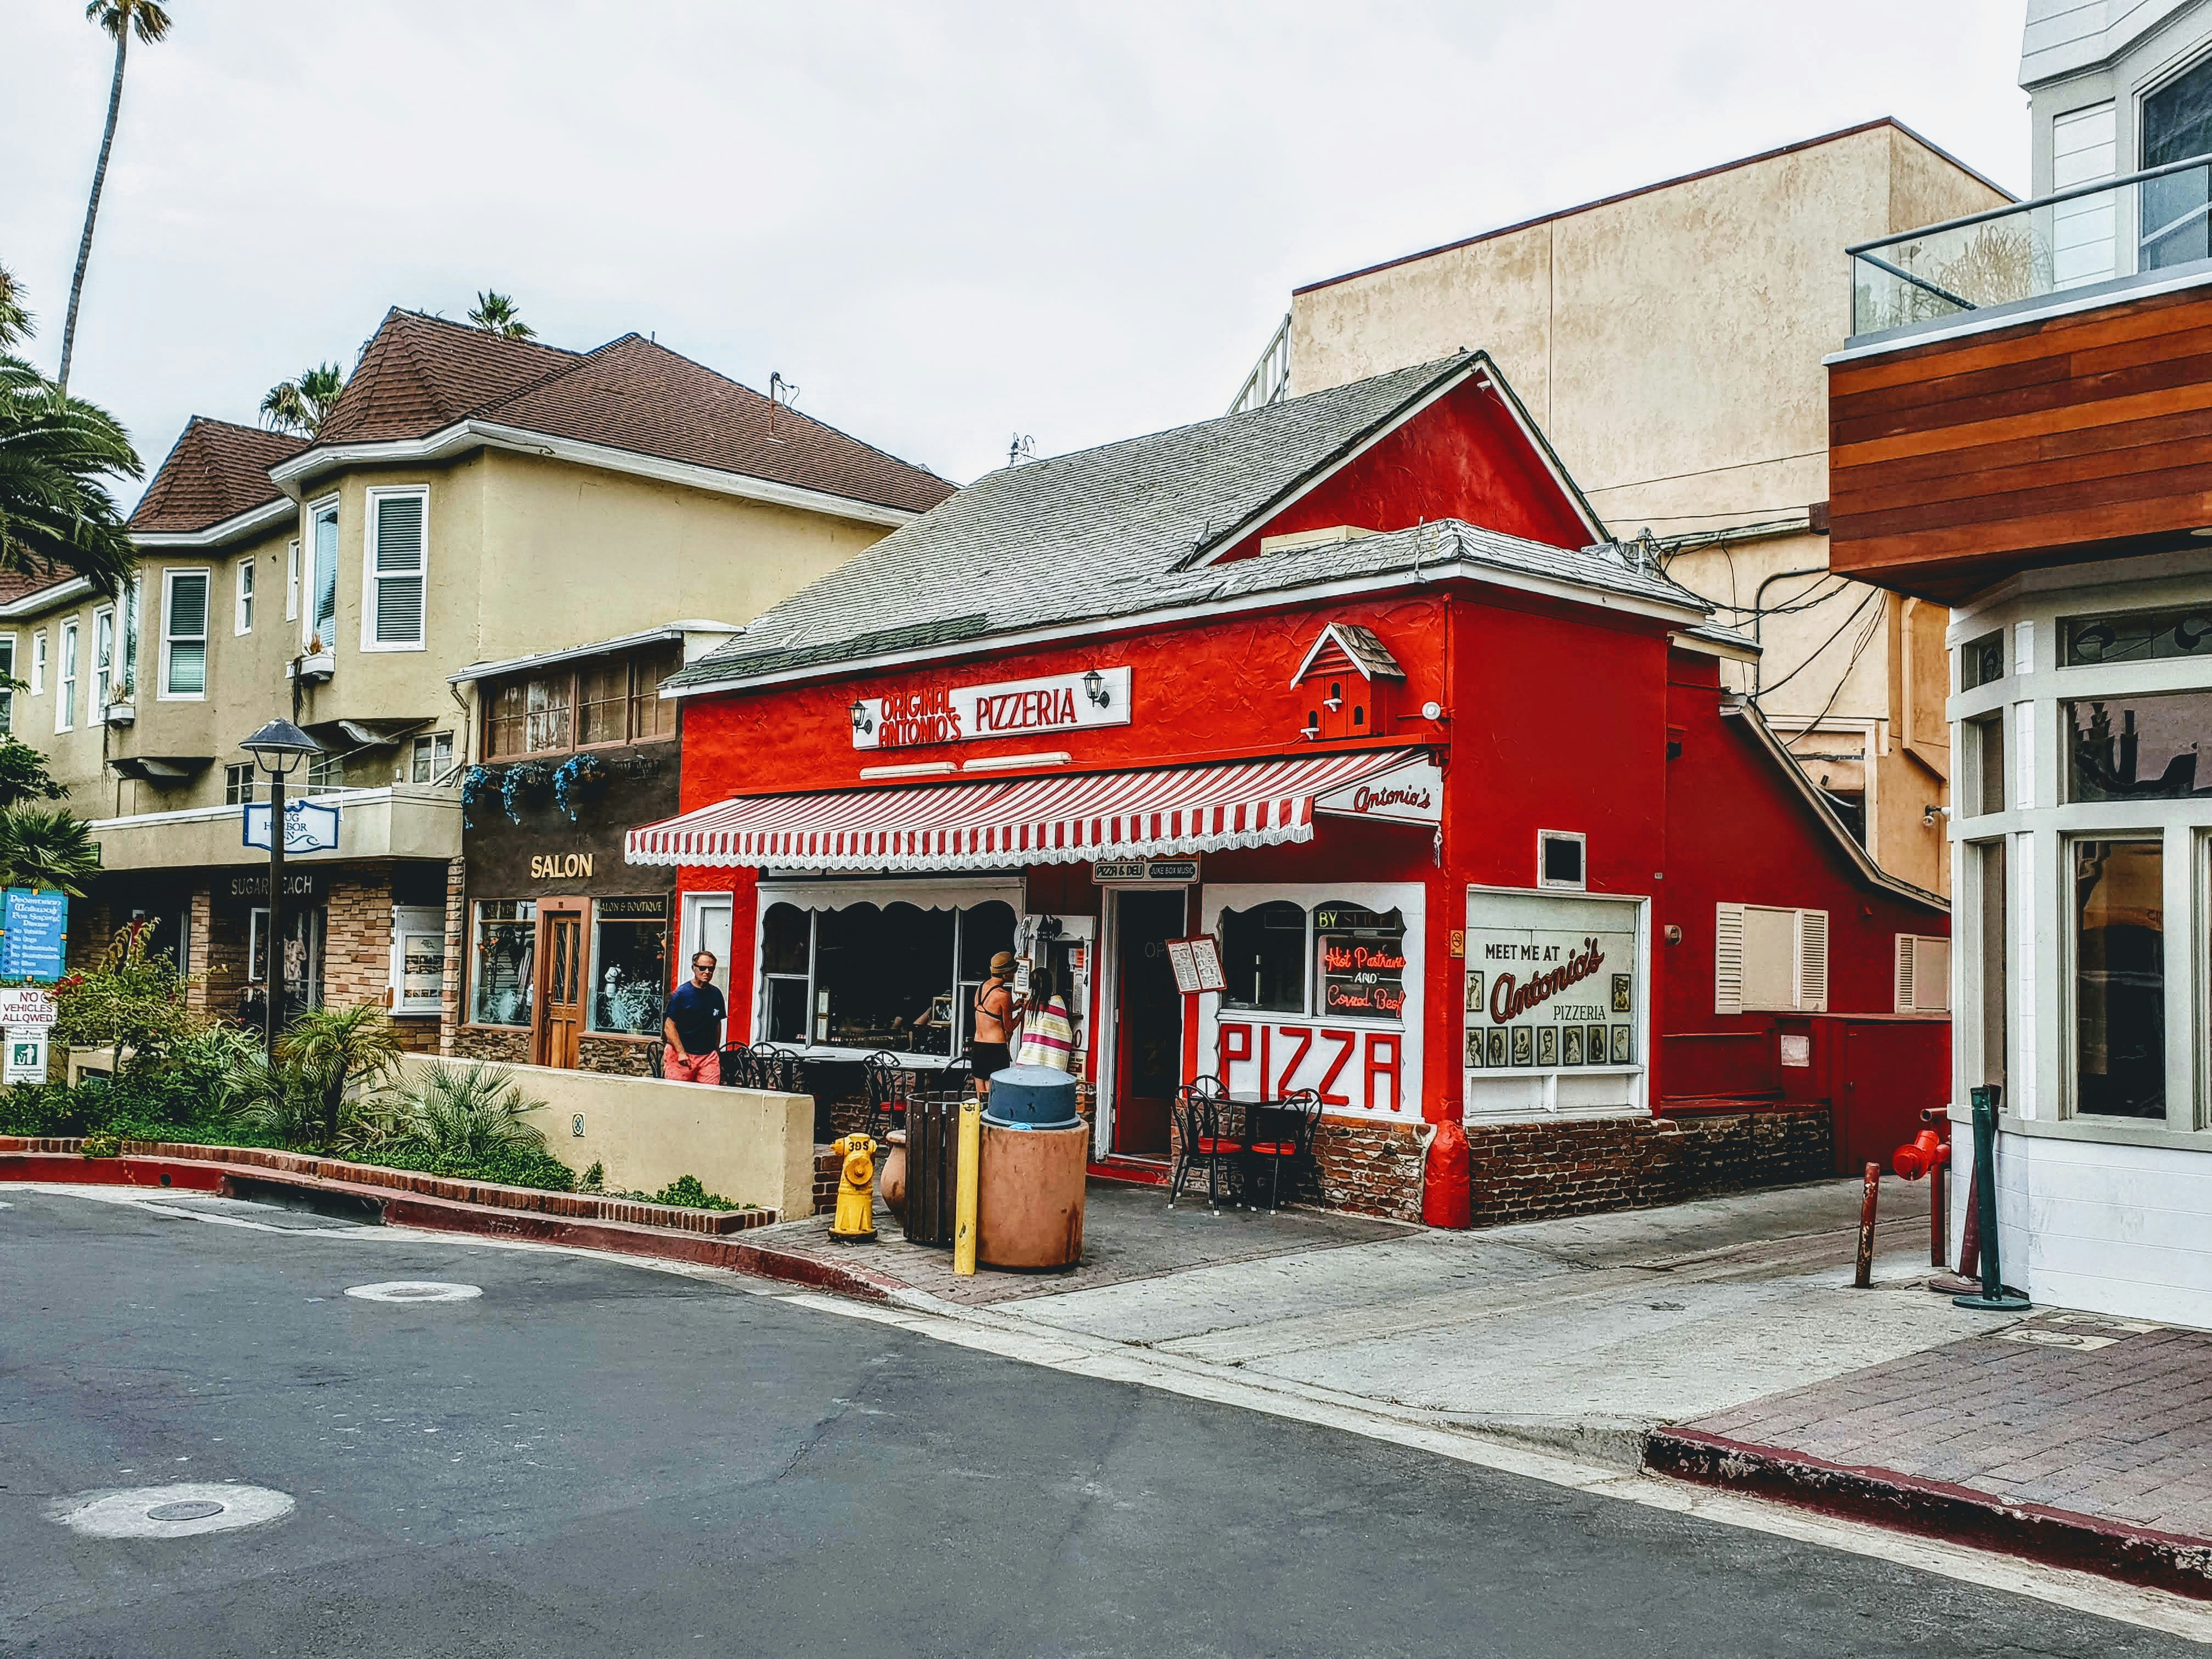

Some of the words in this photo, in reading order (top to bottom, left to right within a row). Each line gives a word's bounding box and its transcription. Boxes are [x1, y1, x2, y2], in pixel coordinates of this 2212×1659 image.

[881, 686, 956, 721] ORIGINAL
[975, 688, 1077, 731] PIZZERIA
[879, 713, 961, 747] ANTONIO'S
[1353, 785, 1431, 813] Antonio's
[285, 813, 300, 822] UG
[264, 822, 308, 831] HBOR
[531, 853, 593, 878] SALON
[1096, 865, 1118, 876] PIZZA
[1126, 865, 1143, 876] DELI
[1177, 866, 1194, 874] MUSIC
[231, 877, 269, 895] SUGAR
[283, 875, 312, 895] ACH
[601, 902, 619, 911] ALON
[1319, 912, 1338, 928] BY
[1144, 941, 1165, 958] OP
[1485, 944, 1517, 960] MEET
[1521, 945, 1539, 961] ME
[1543, 946, 1560, 961] AT
[1325, 947, 1351, 971] Hot
[1354, 972, 1377, 984] AND
[1489, 936, 1605, 1025] Antonio's
[20, 992, 38, 1002] NO
[1328, 985, 1373, 1007] Corned
[1374, 988, 1404, 1018] Beef
[3, 1004, 53, 1012] VEHICLES
[1553, 1005, 1606, 1021] PIZZERIA
[2, 1014, 53, 1023] ALLOWED
[1218, 1023, 1402, 1112] PIZZA
